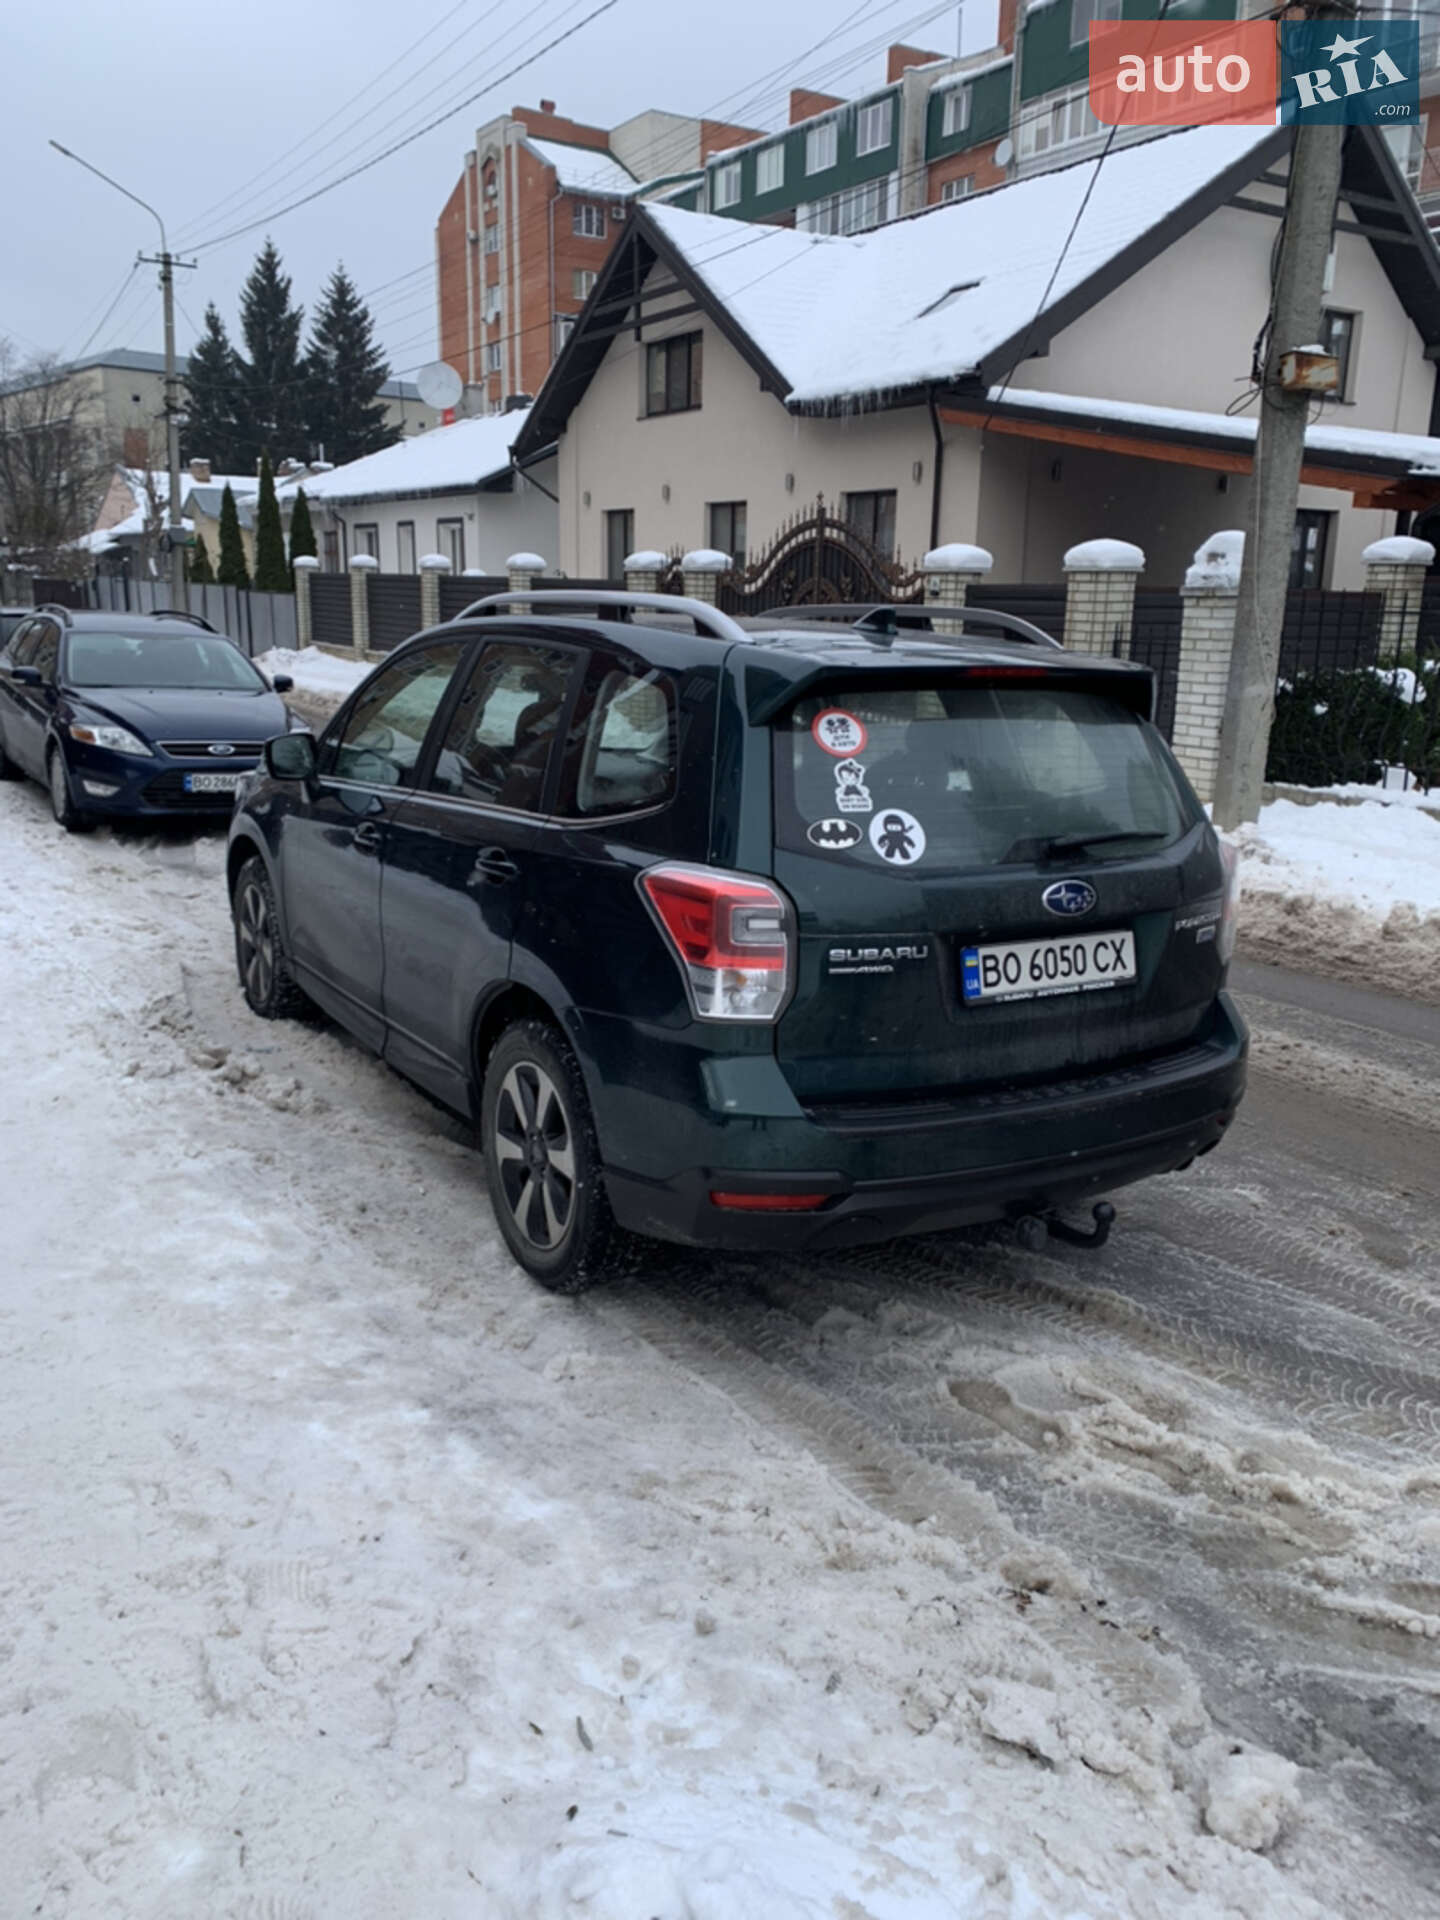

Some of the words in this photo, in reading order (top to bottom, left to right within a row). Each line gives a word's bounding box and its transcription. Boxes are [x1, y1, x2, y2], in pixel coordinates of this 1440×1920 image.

[829, 945, 928, 961] SUBARU
[982, 952, 1021, 988] BO
[1029, 943, 1087, 981] 6050
[1093, 938, 1127, 973] CX
[966, 979, 980, 989] UA
